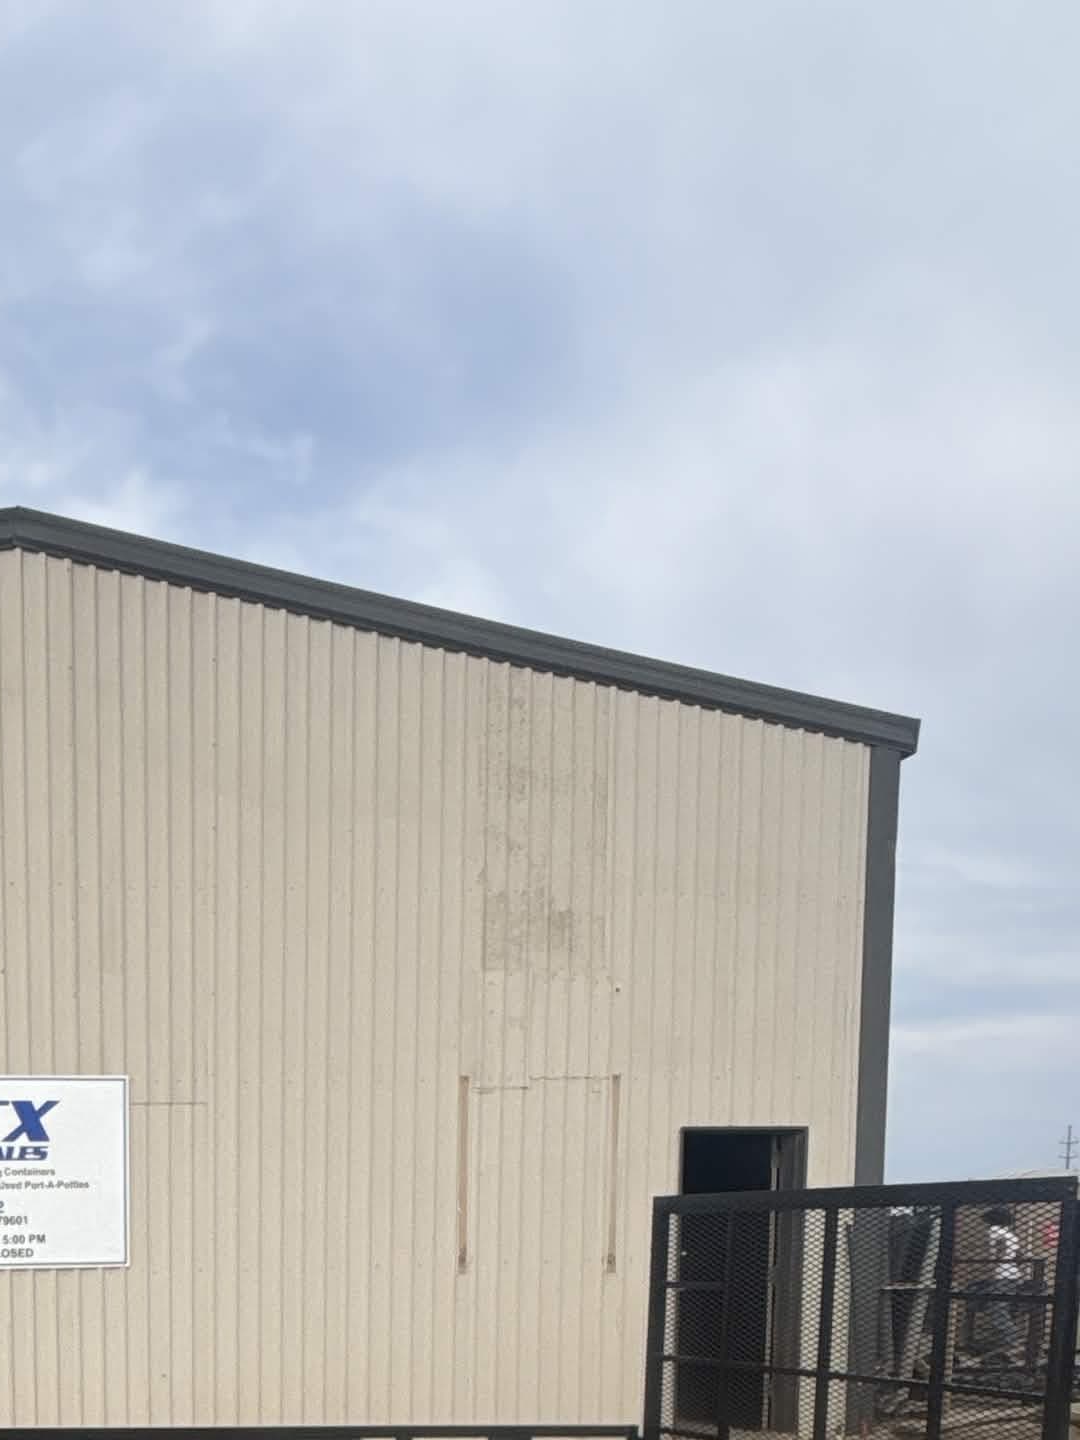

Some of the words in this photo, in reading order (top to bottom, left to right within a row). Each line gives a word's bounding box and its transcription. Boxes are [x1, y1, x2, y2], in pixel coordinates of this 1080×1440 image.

[4, 1167, 56, 1176] Containers
[2, 1235, 26, 1245] 5:00
[28, 1234, 46, 1244] PM
